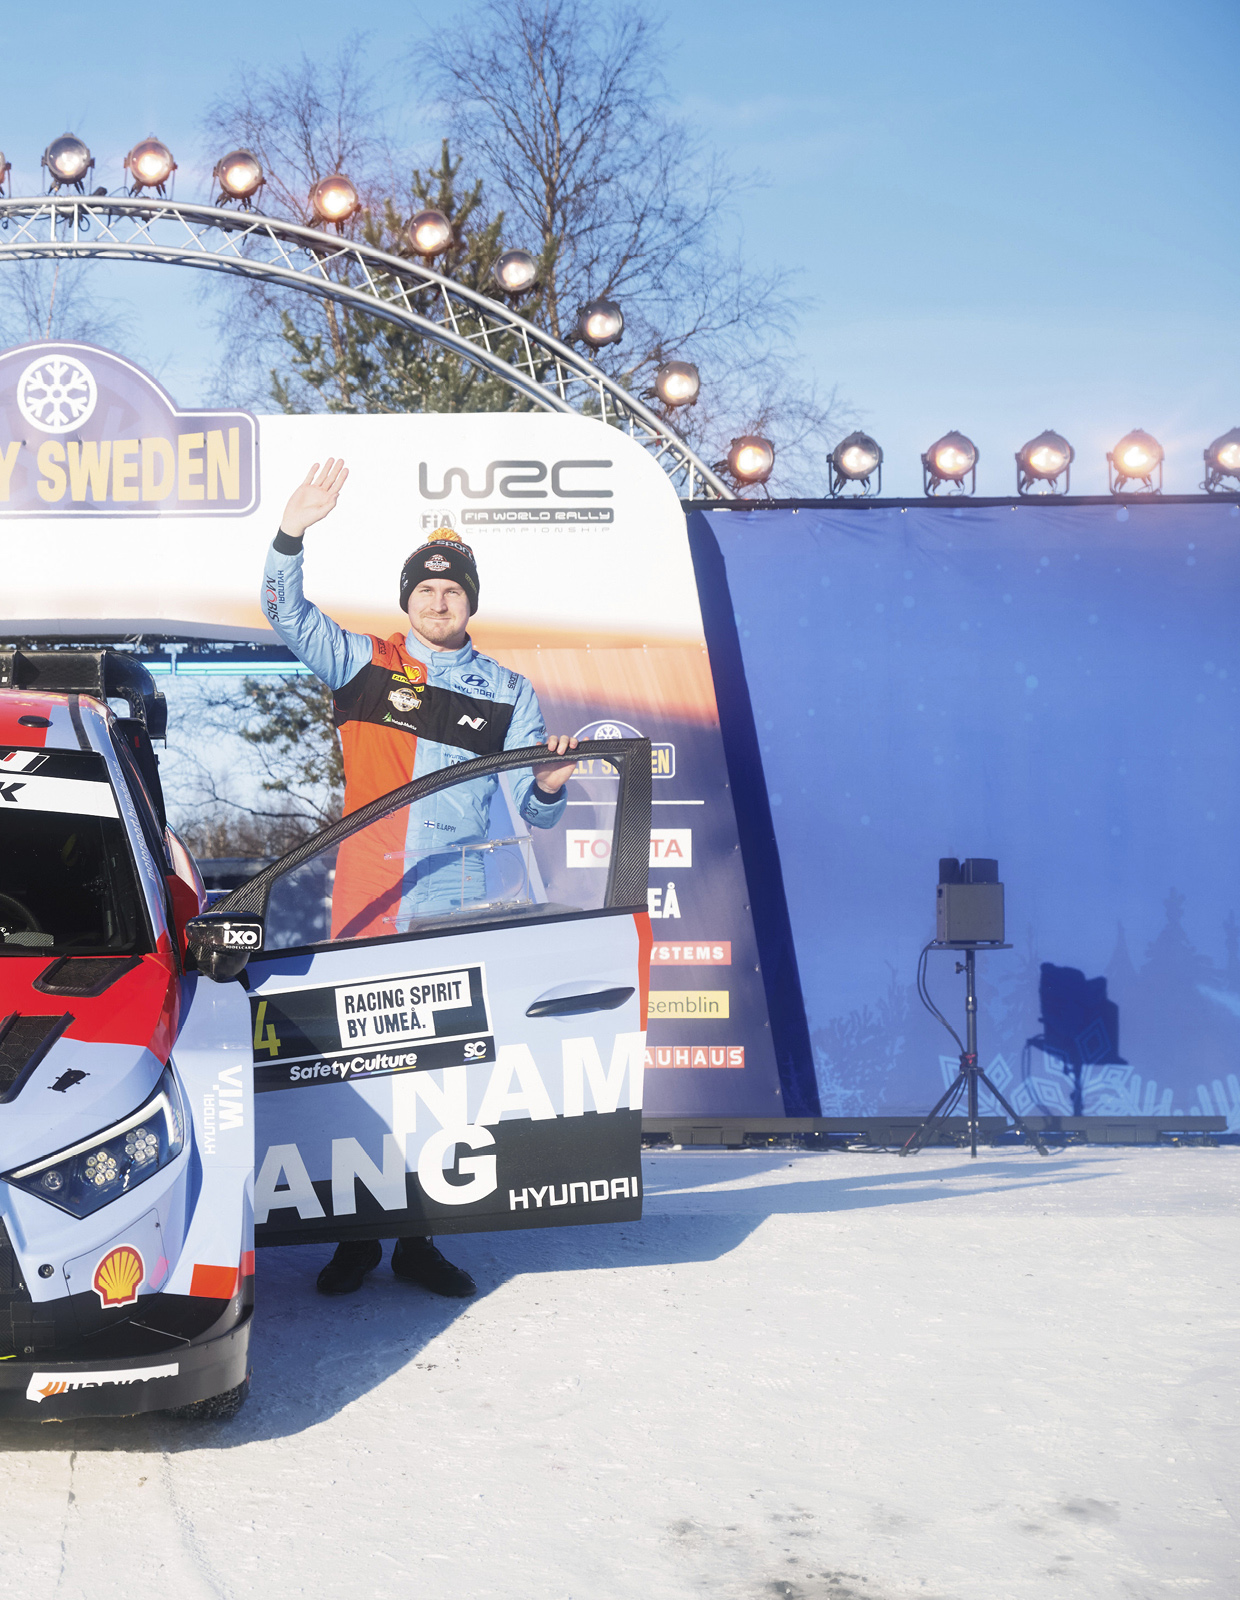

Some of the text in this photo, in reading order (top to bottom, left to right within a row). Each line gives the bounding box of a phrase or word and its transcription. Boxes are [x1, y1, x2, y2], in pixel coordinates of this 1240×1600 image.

[36, 426, 241, 503] SWEDEN
[418, 459, 614, 500] WRC
[465, 511, 611, 521] FIA WORLD RALLY
[465, 526, 611, 534] CHAMPIONSHIP
[265, 574, 280, 623] MOBIS
[277, 569, 285, 604] HYUNDAI
[454, 683, 496, 699] HYUNDAI
[436, 822, 457, 833] E.LAPPI
[344, 980, 462, 1015] RACING SPIRIT
[647, 996, 720, 1013] semblin
[253, 1000, 282, 1057] 4
[347, 1007, 427, 1039] BY UMEÅ.
[289, 1052, 418, 1080] SafetyCulture
[463, 1040, 487, 1058] SC
[392, 1031, 647, 1133] NAM
[203, 1093, 216, 1155] HYUNDAI
[254, 1123, 498, 1225] ANG
[508, 1176, 639, 1211] HYUNDAI
